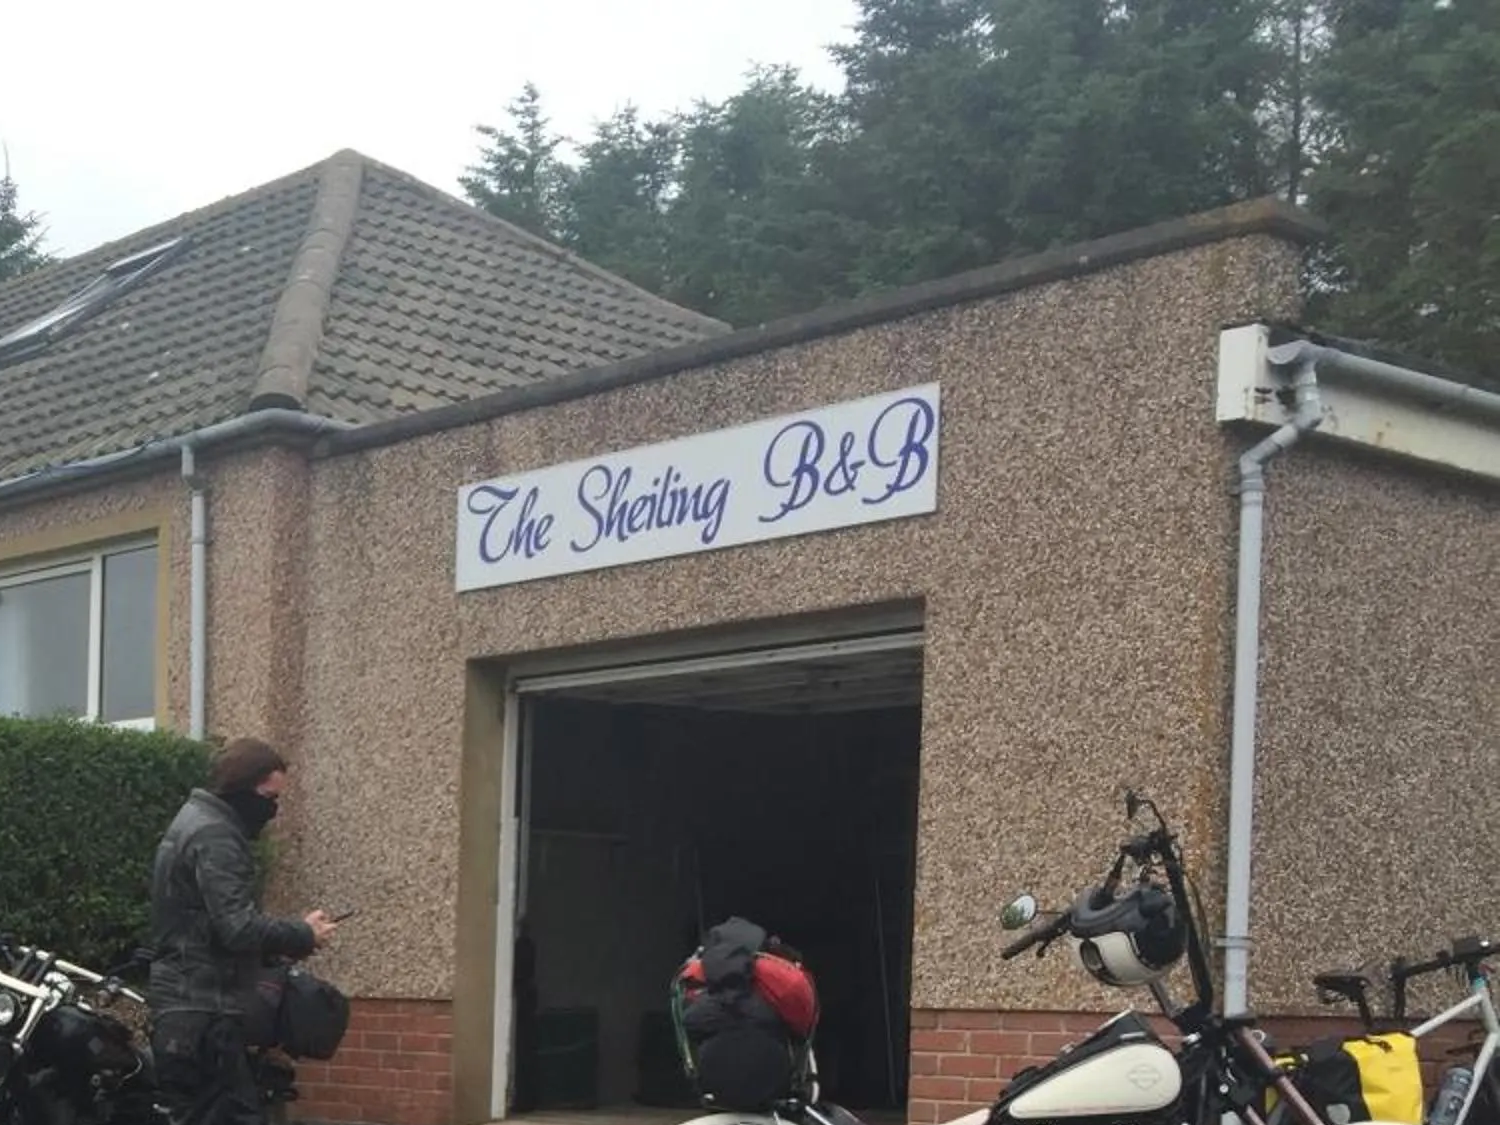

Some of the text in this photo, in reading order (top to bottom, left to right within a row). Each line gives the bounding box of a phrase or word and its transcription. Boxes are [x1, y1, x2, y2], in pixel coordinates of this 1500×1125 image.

[467, 397, 935, 564] The Sheiling B&B
